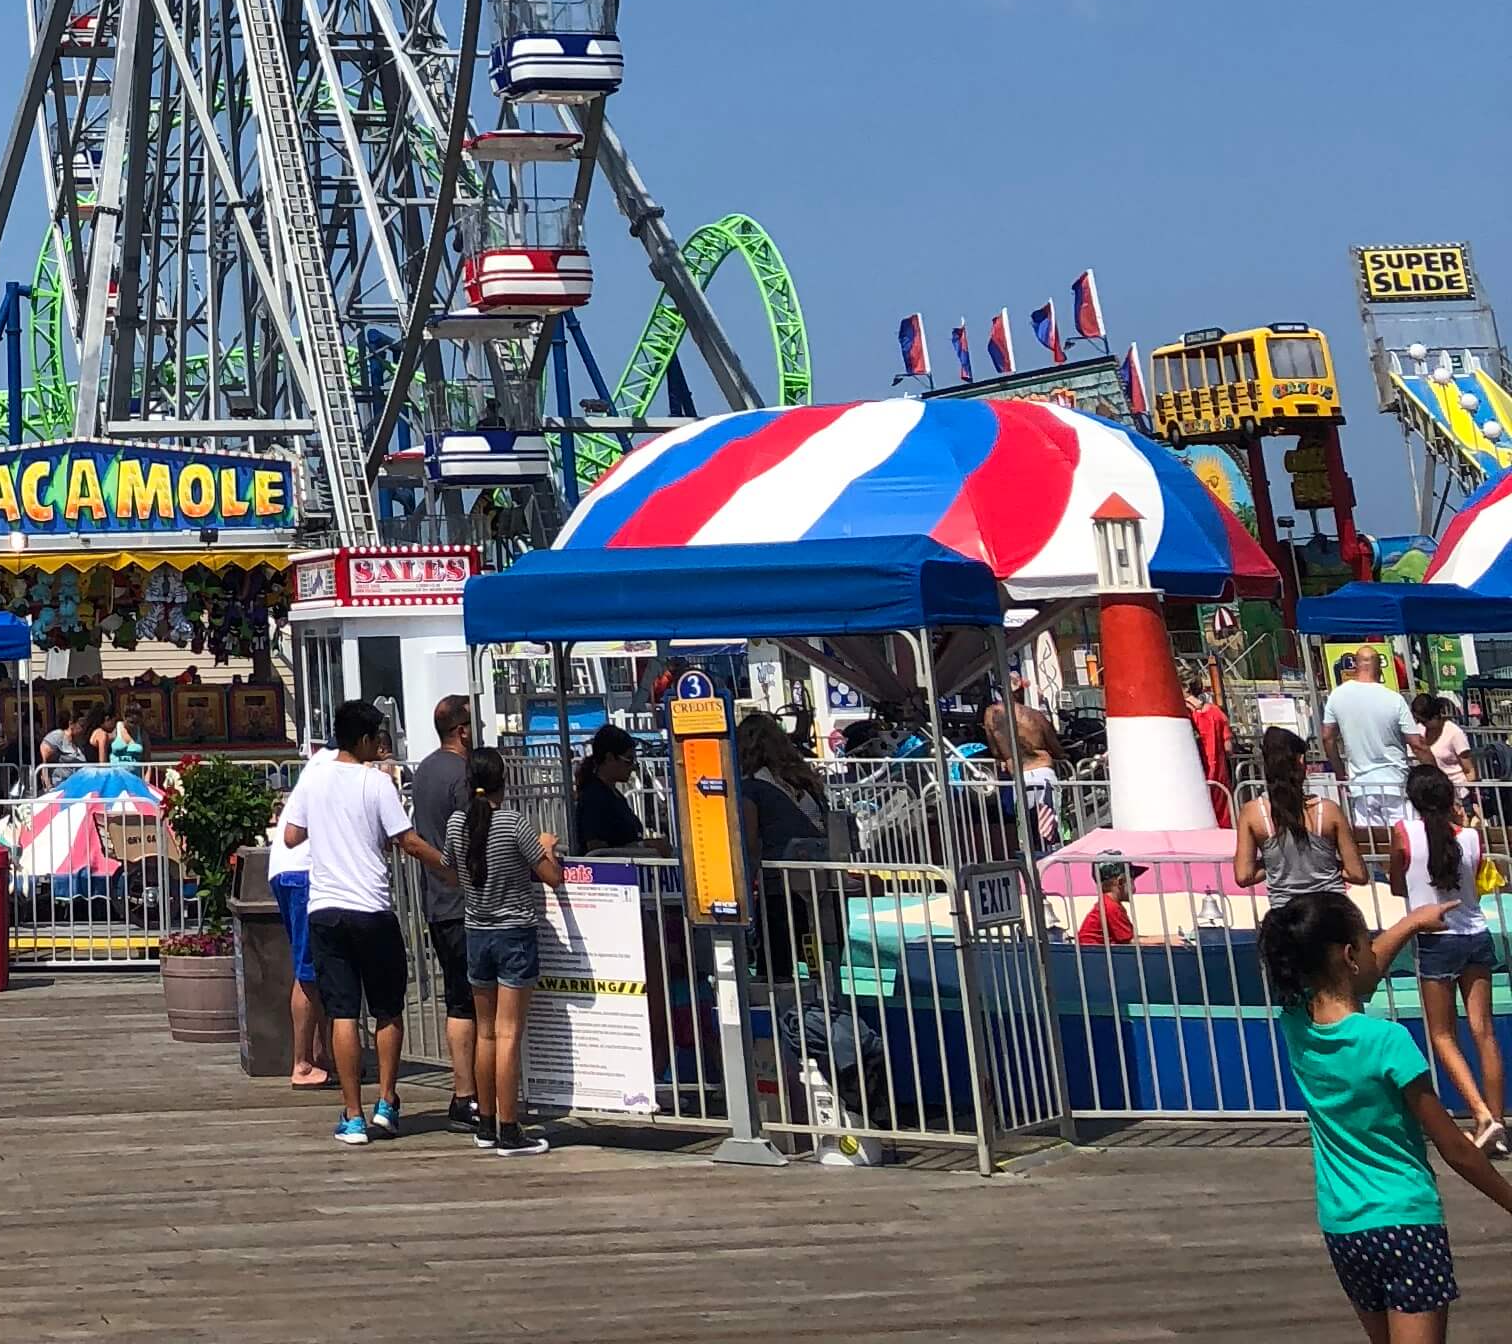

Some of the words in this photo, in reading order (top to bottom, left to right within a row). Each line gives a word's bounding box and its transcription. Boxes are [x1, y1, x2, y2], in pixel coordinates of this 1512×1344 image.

[1370, 252, 1459, 272] SUPER
[1373, 272, 1465, 292] SLIDE
[1273, 382, 1308, 400] CRAZY
[1309, 383, 1334, 401] BUS
[354, 558, 467, 584] SALES
[687, 675, 702, 698] 3
[672, 701, 723, 714] CREDITS
[978, 876, 1012, 916] EXIT
[545, 979, 617, 993] WARNING
